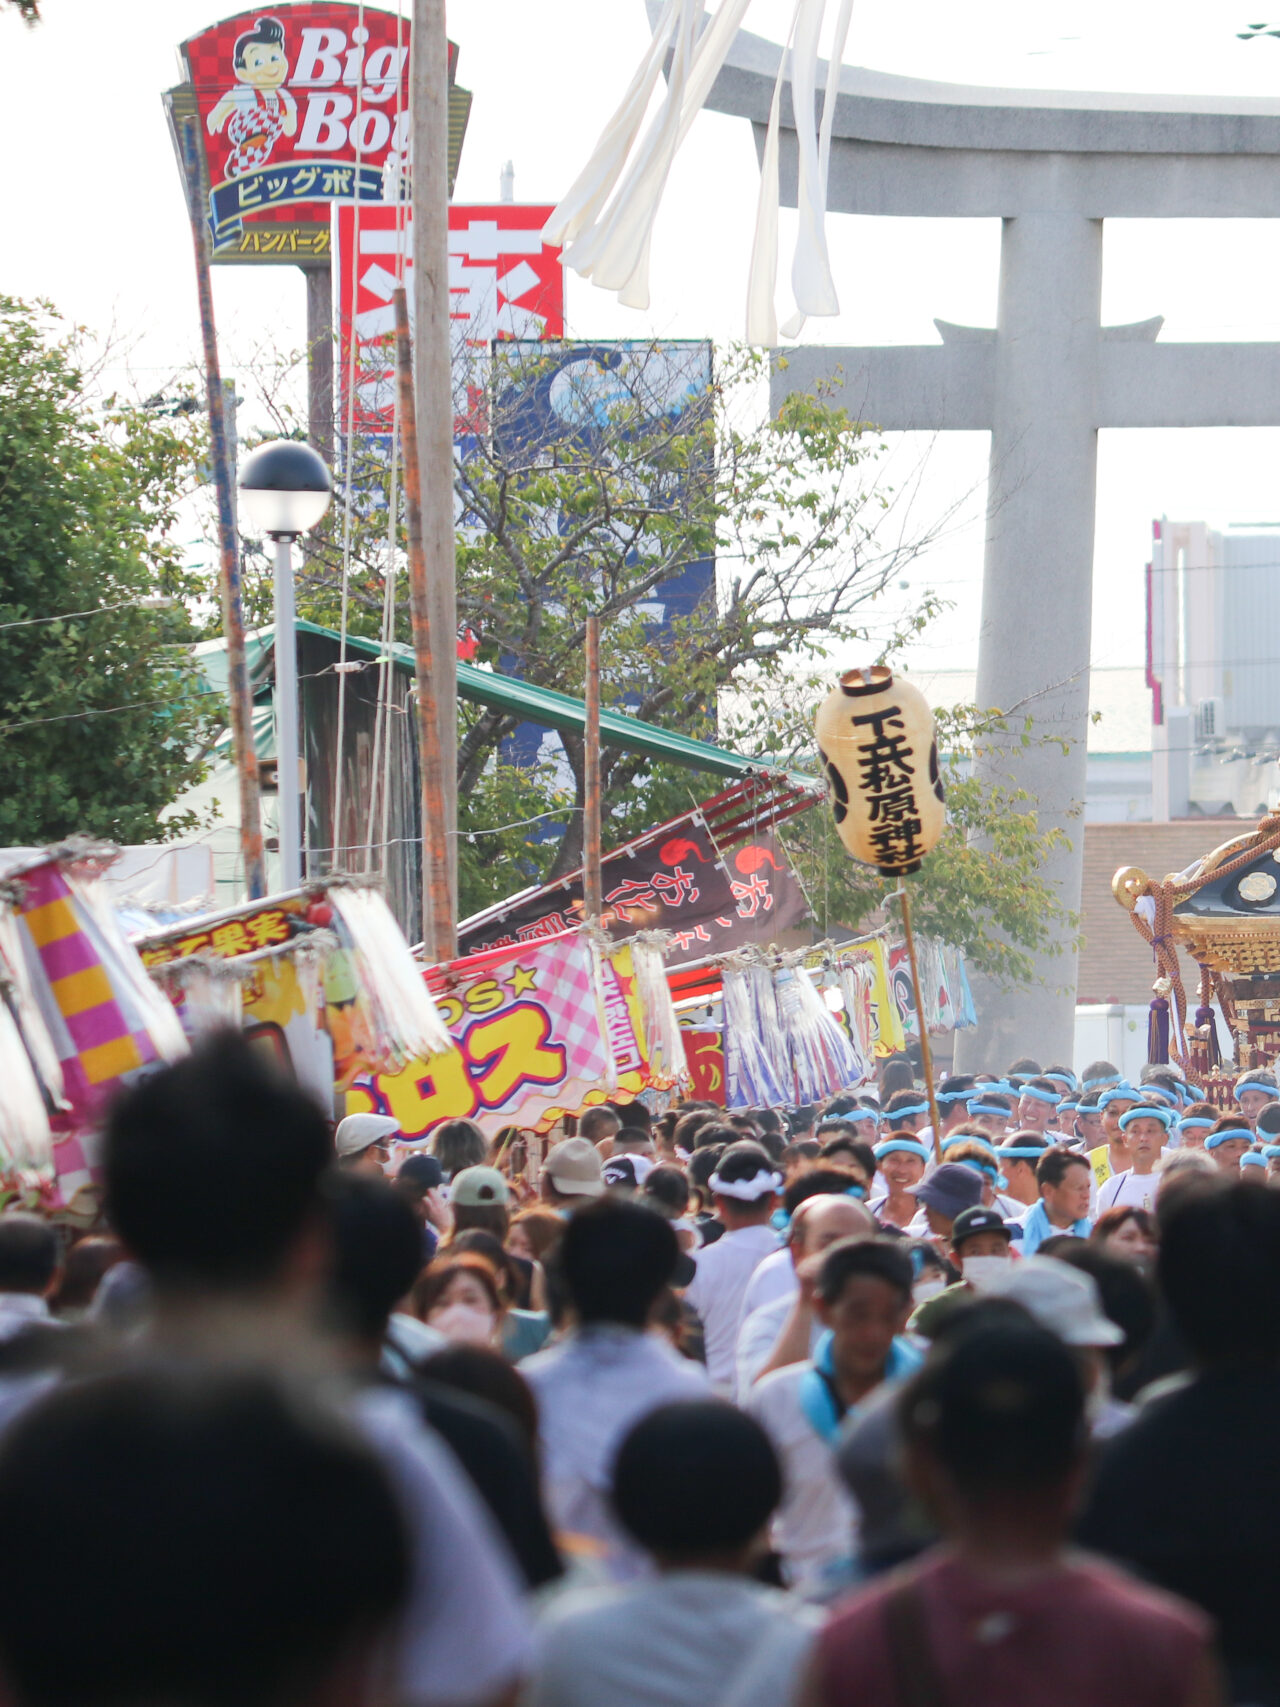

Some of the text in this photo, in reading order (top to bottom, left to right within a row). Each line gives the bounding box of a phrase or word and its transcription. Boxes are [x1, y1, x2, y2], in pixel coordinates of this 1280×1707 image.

[288, 26, 408, 103] Big
[238, 167, 403, 207] ビッグボー
[346, 1003, 566, 1139] ロス
